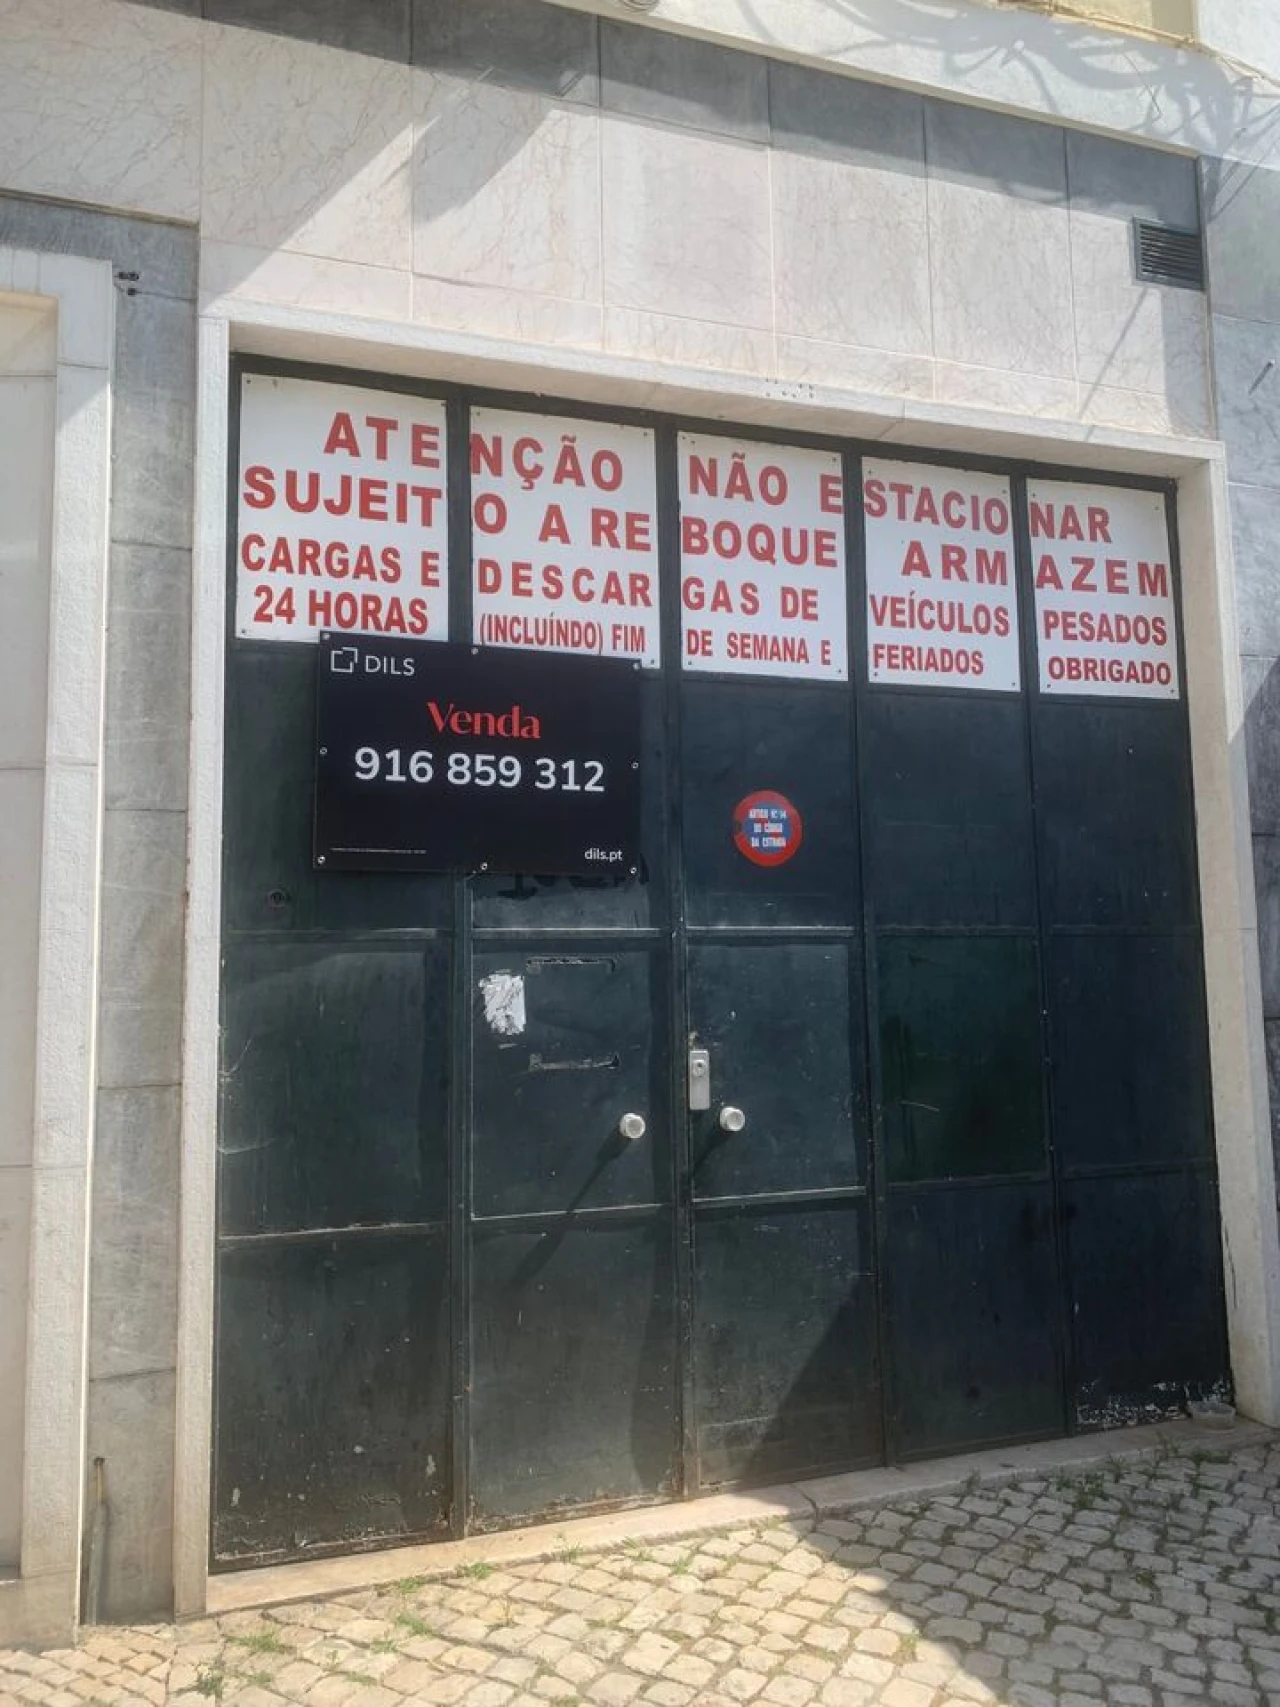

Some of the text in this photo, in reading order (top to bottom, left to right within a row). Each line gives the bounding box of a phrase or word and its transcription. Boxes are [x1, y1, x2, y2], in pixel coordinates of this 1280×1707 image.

[688, 452, 788, 506] NÃO
[538, 504, 571, 545] A
[241, 533, 401, 584] CARGAS
[420, 551, 440, 588] E
[780, 586, 819, 622] DE
[870, 590, 1010, 637] VEÍCULOS
[1044, 610, 1168, 647] PESADOS
[253, 584, 296, 625] 24
[308, 589, 429, 634] HORAS
[611, 623, 647, 653] FIM
[687, 629, 713, 657] DE
[727, 632, 809, 664] SEMANA
[821, 640, 831, 666] E
[874, 644, 984, 675] FERIADOS
[1048, 655, 1172, 686] OBRIGADO
[365, 655, 416, 676] DILS
[427, 700, 541, 740] Venda
[355, 747, 605, 793] 916 859 312
[584, 848, 623, 863] dils.pt
